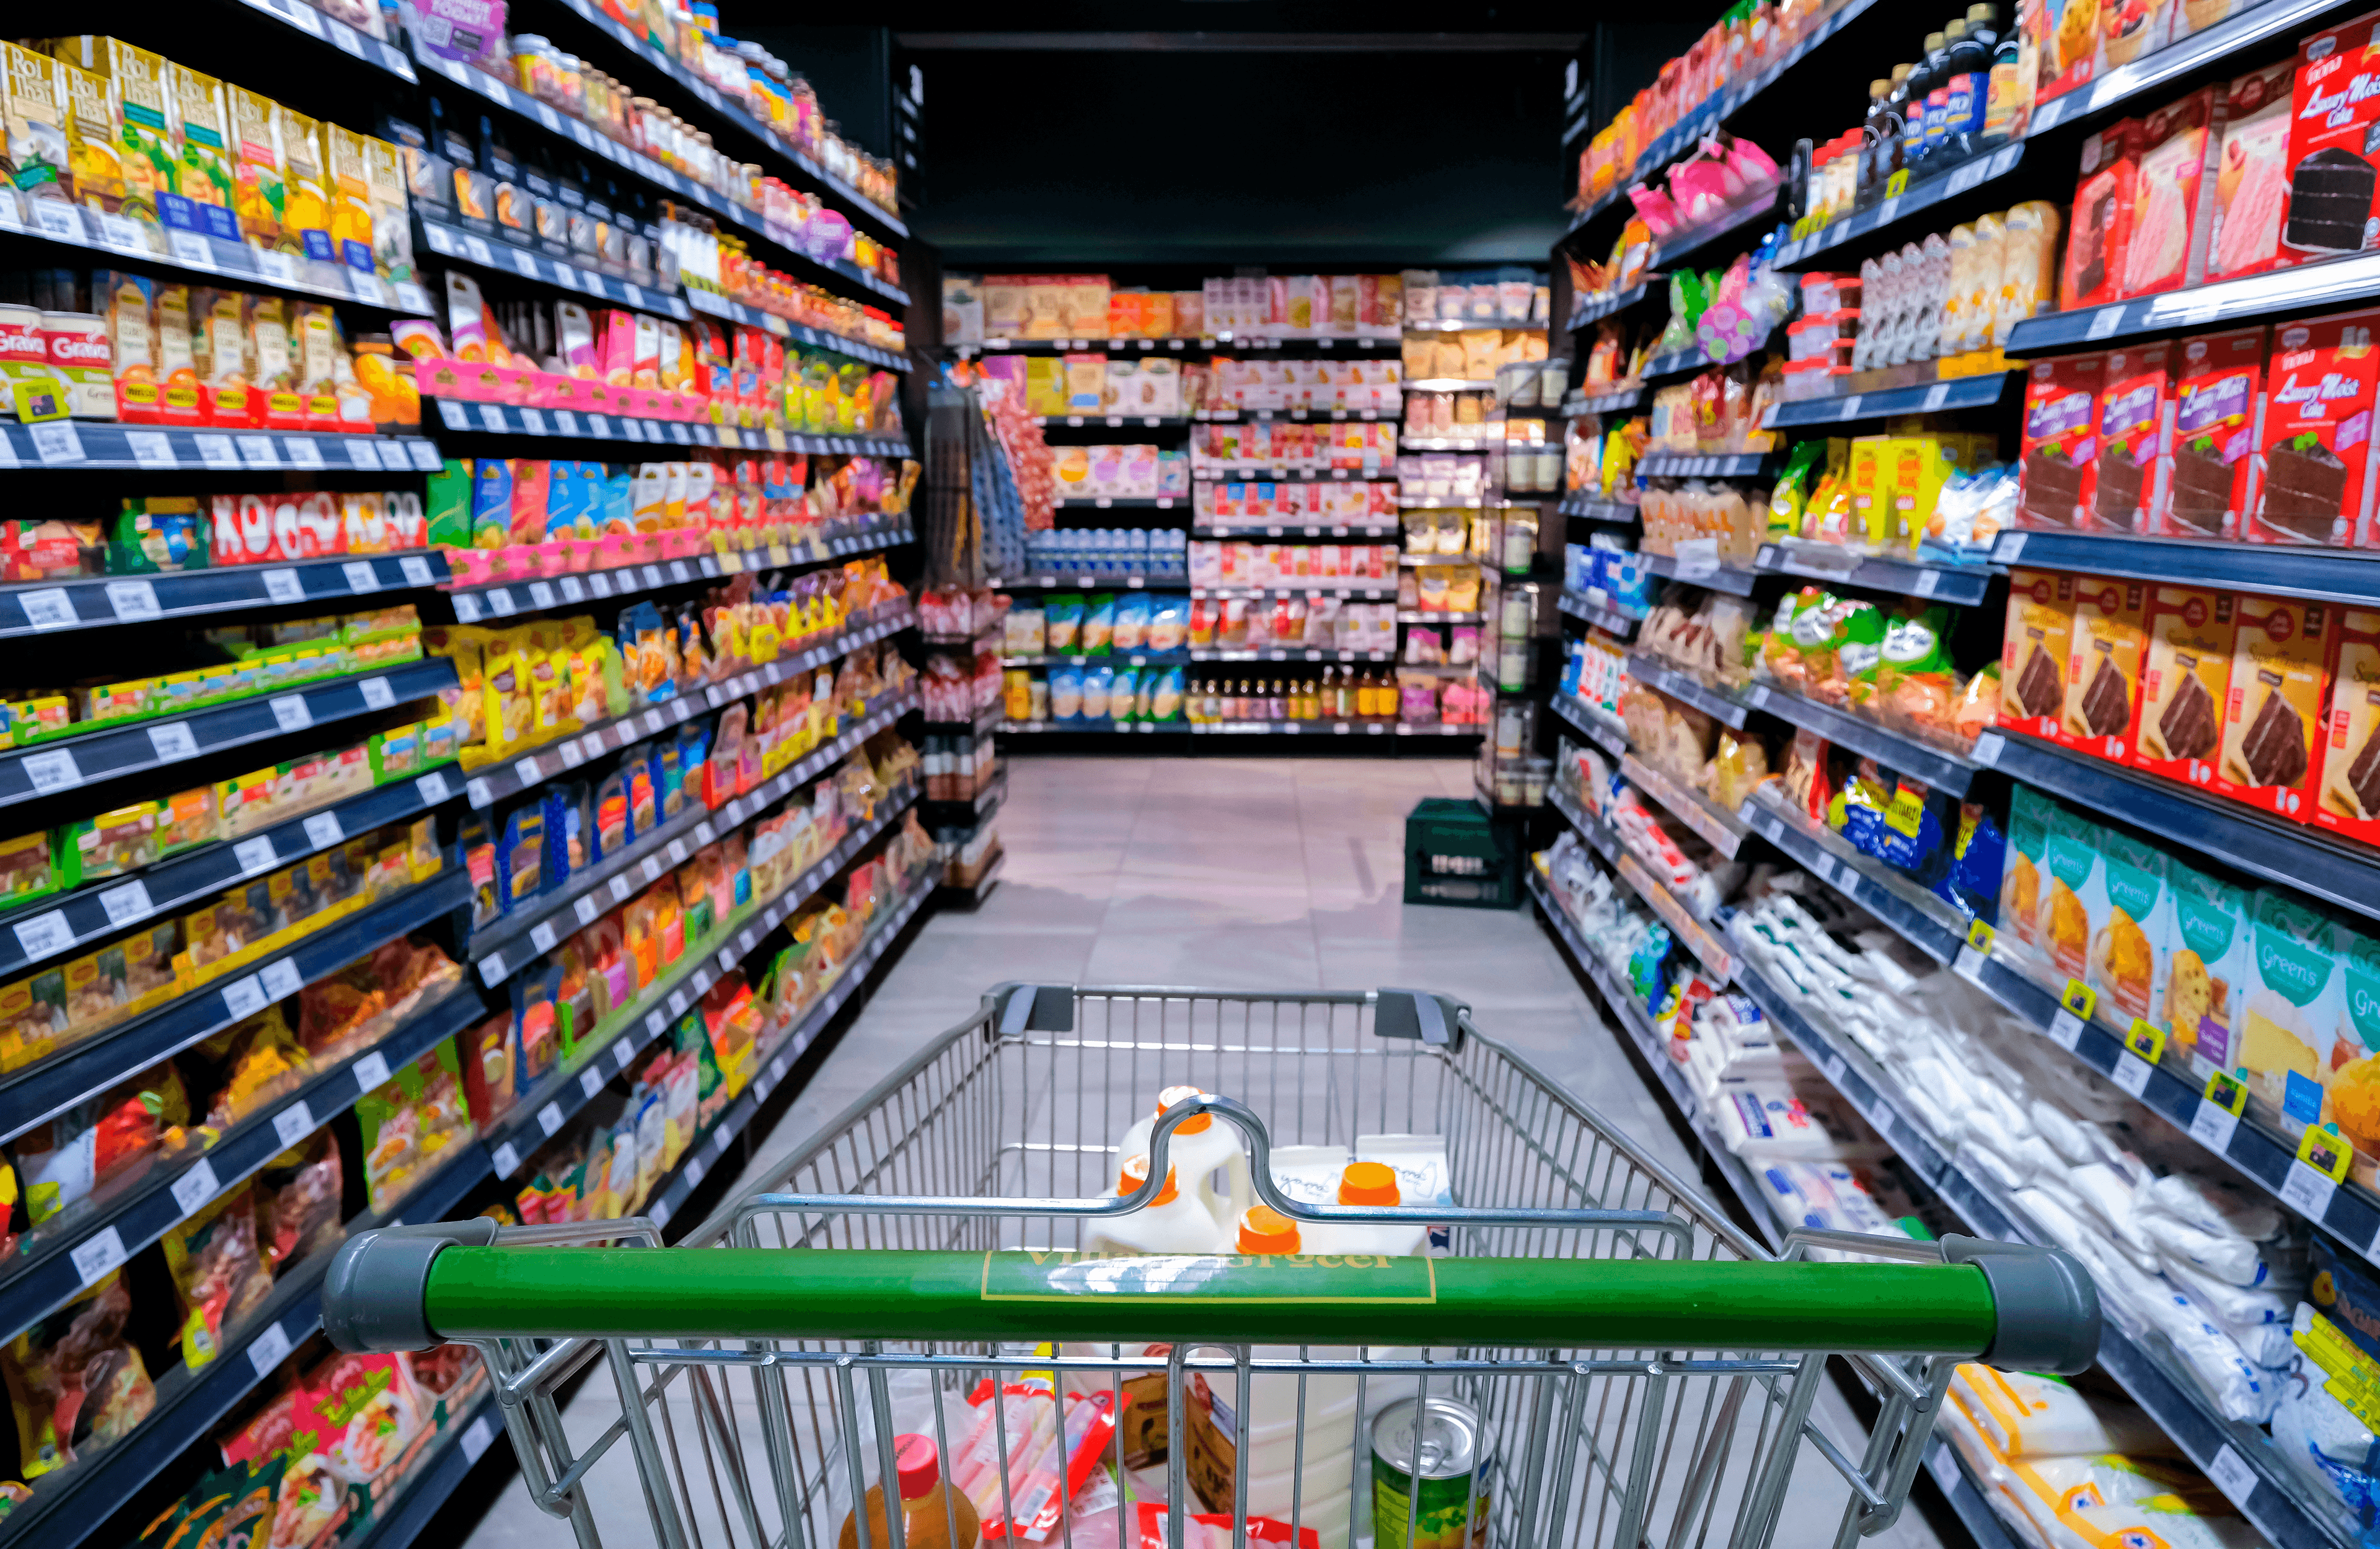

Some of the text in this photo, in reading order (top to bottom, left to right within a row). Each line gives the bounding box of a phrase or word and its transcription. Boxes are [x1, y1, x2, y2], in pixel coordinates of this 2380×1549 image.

[11, 47, 42, 79] Roi
[122, 44, 151, 79] Roi
[71, 68, 99, 98] Roi
[2299, 84, 2349, 120] Luxury
[2273, 373, 2361, 405] Luxury Moist
